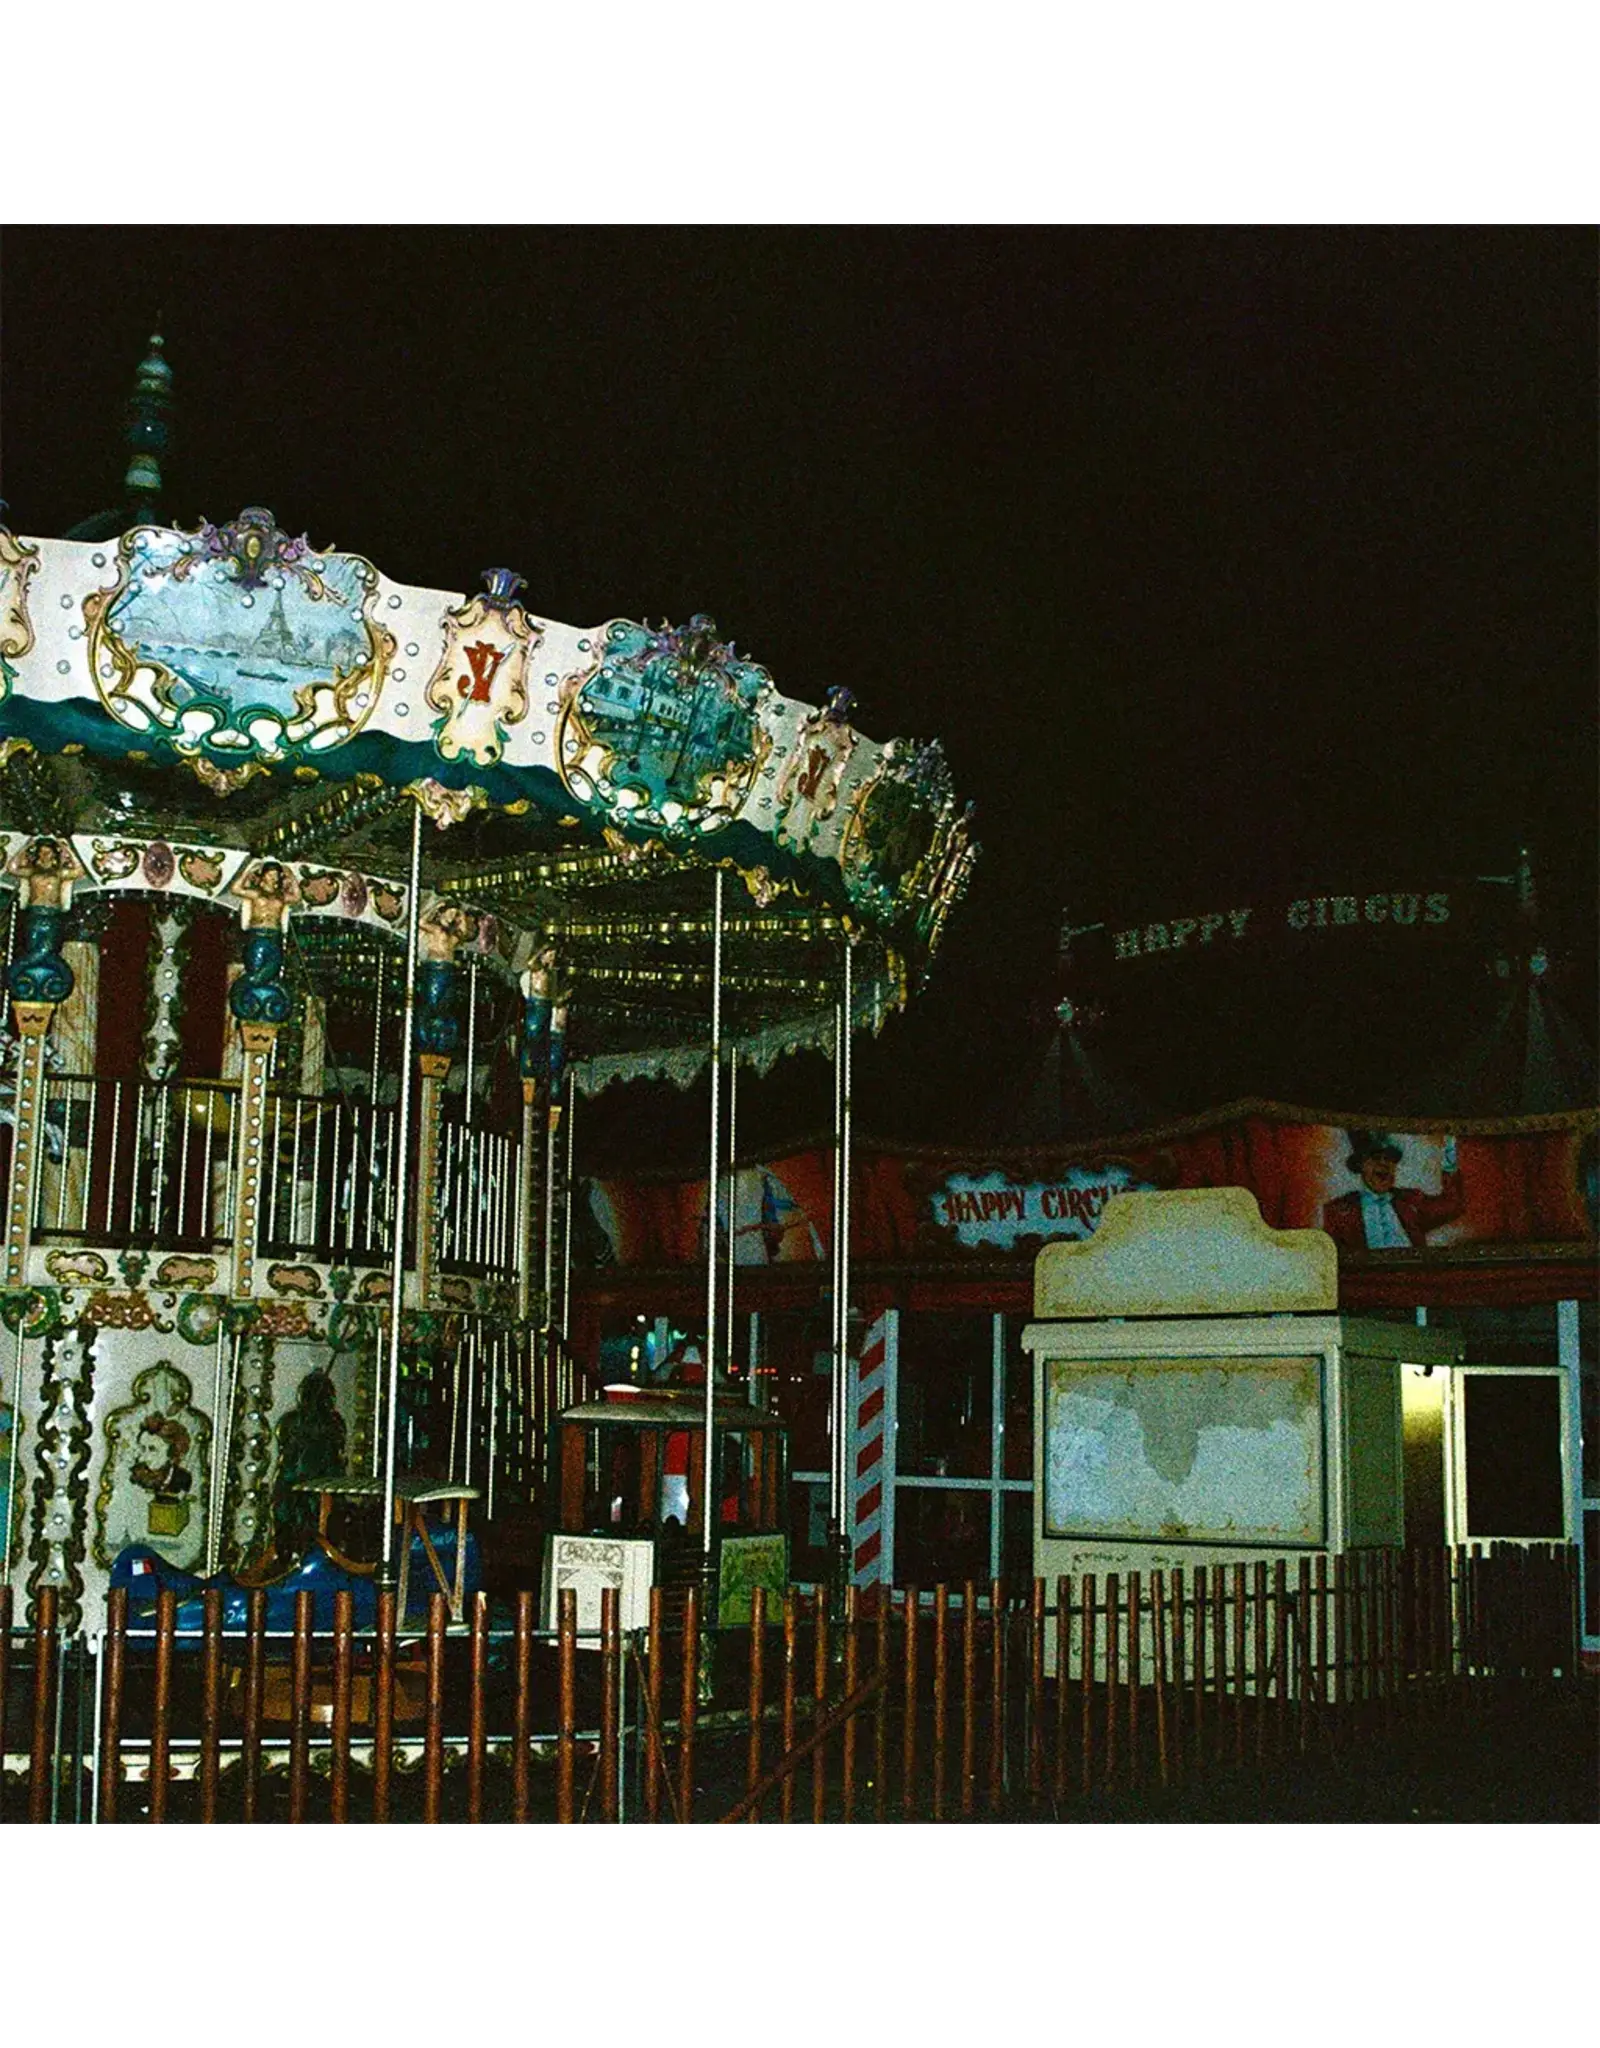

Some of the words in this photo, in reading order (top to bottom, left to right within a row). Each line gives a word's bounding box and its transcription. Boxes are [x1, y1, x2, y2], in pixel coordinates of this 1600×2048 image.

[1112, 907, 1253, 959] HAPPY
[1286, 892, 1450, 930] CIRCUS
[942, 1190, 1026, 1222] HAPPY
[1041, 1185, 1132, 1232] CIRC
